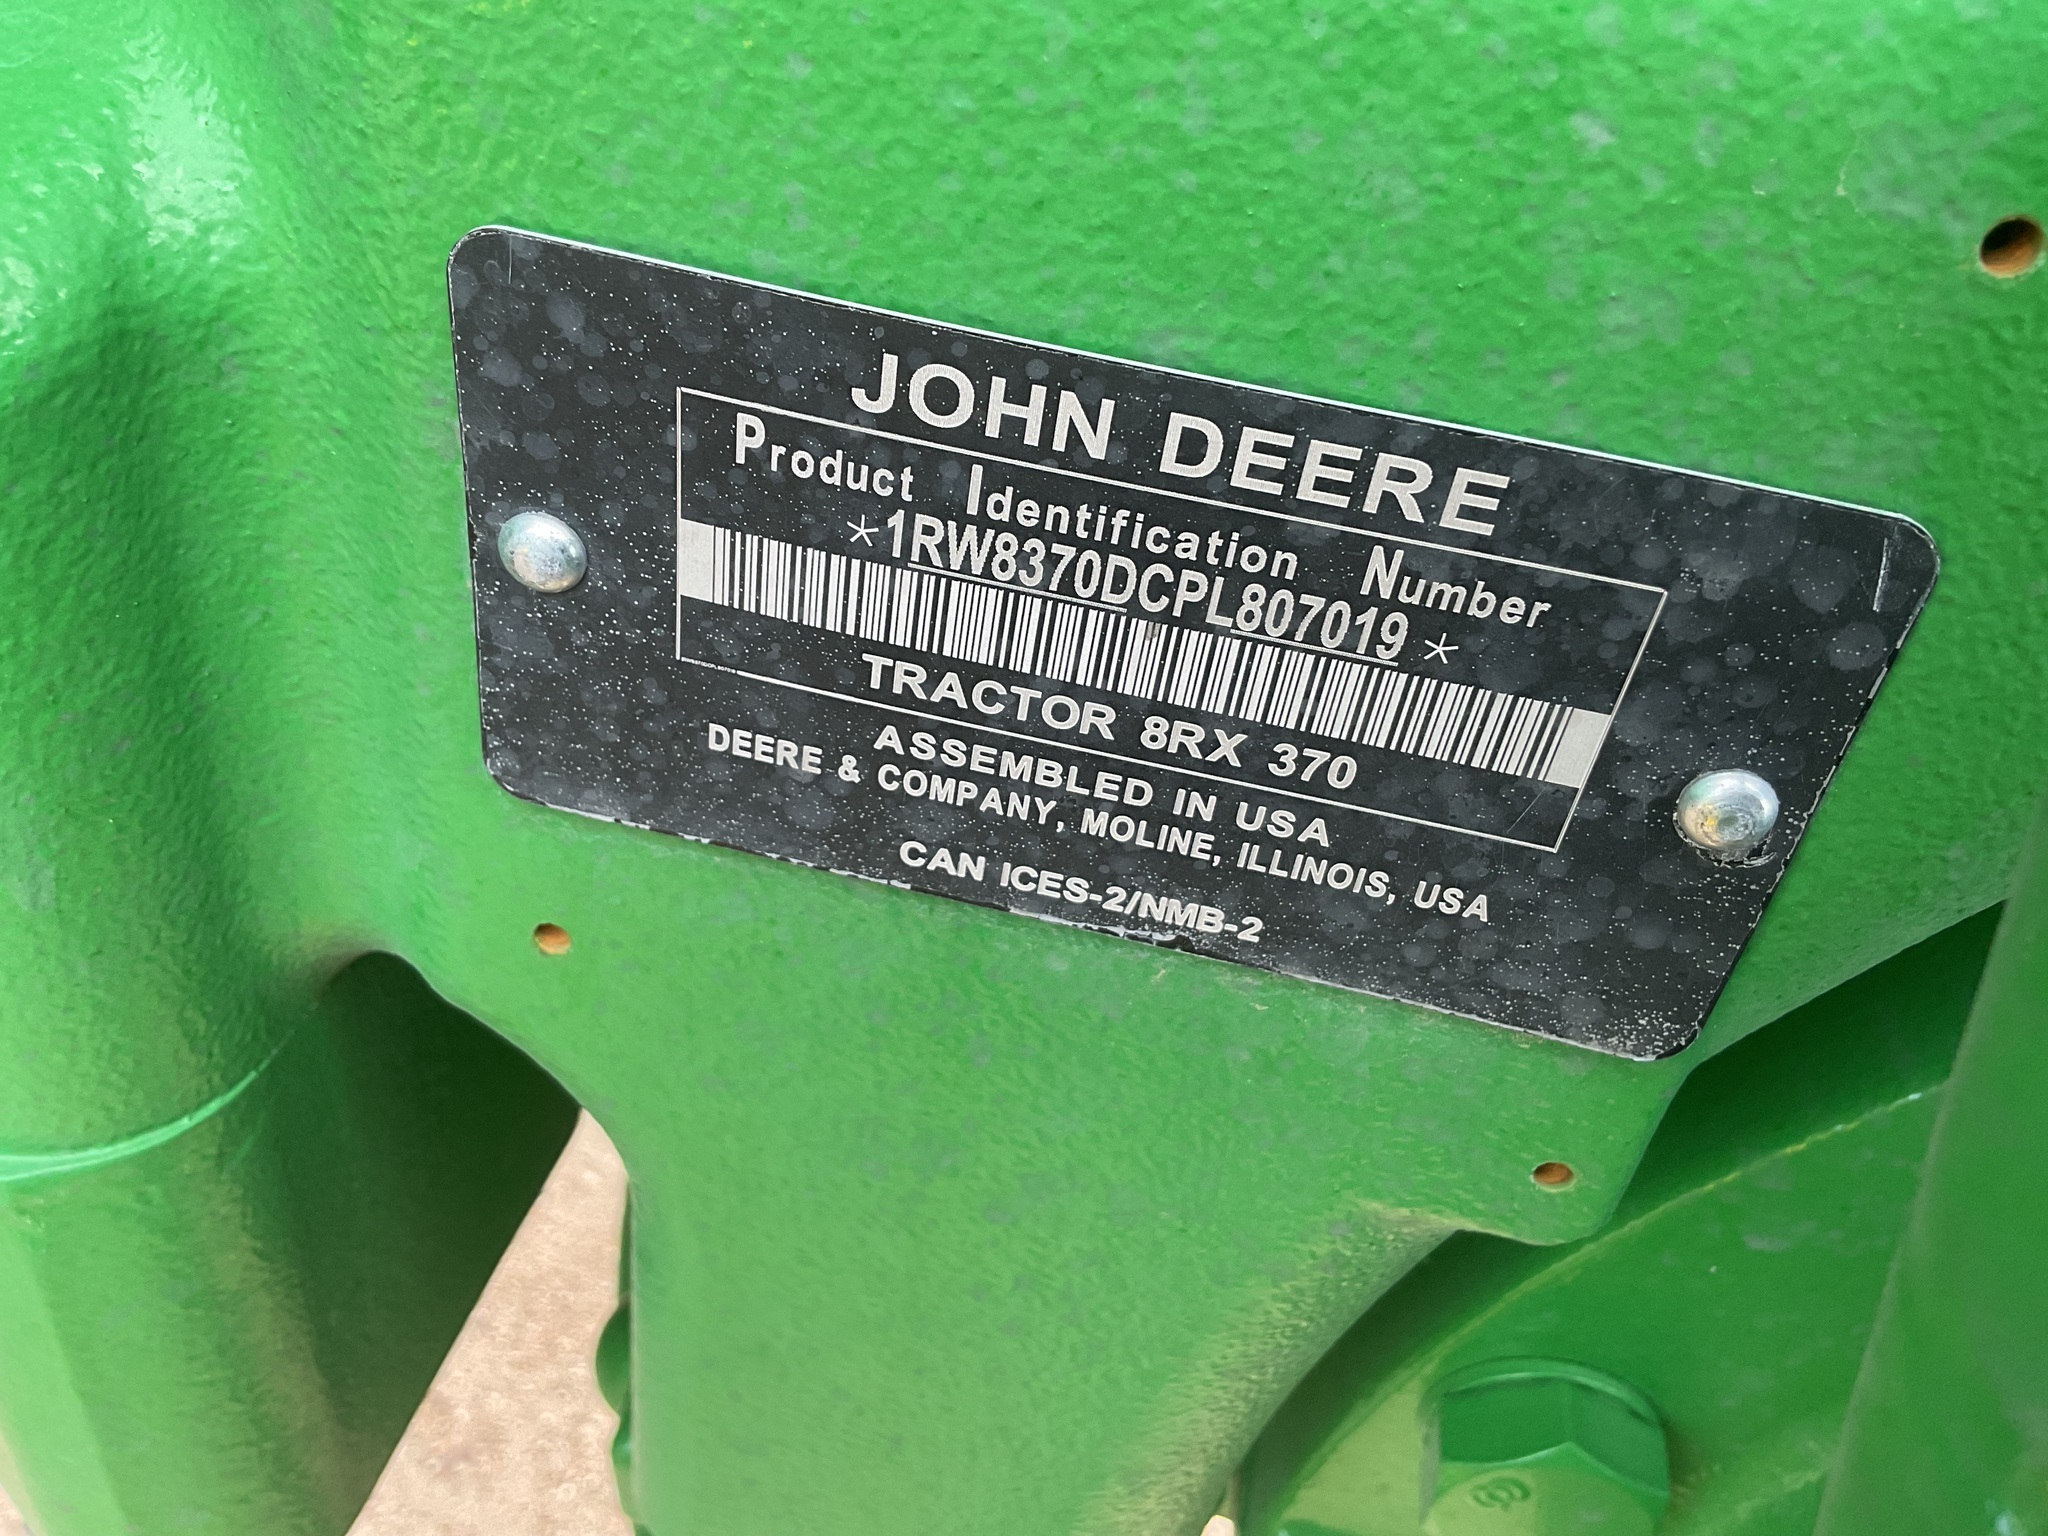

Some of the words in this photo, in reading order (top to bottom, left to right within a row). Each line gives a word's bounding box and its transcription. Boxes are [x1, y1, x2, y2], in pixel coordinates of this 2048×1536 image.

[735, 412, 914, 502] Product
[966, 464, 1298, 581] Identification
[1360, 545, 1552, 628] Number
[851, 353, 1116, 460] JOHN
[1159, 411, 1510, 536] DEERE
[862, 653, 1117, 740] TRACTOR
[1140, 715, 1248, 768] 8RX
[1268, 743, 1358, 790] 370
[874, 725, 1153, 807] ASSEMBLED
[1172, 788, 1218, 822] IN
[1236, 802, 1330, 848] USA
[708, 723, 823, 775] DEERE
[837, 754, 861, 783] &
[878, 764, 1065, 832] COMPANY,
[1080, 808, 1221, 867] MOLINE,
[1237, 842, 1396, 905] ILLINOIS,
[1413, 880, 1489, 922] USA
[900, 841, 985, 881] CAN
[1000, 862, 1264, 943] ICES-2/NMB-2
